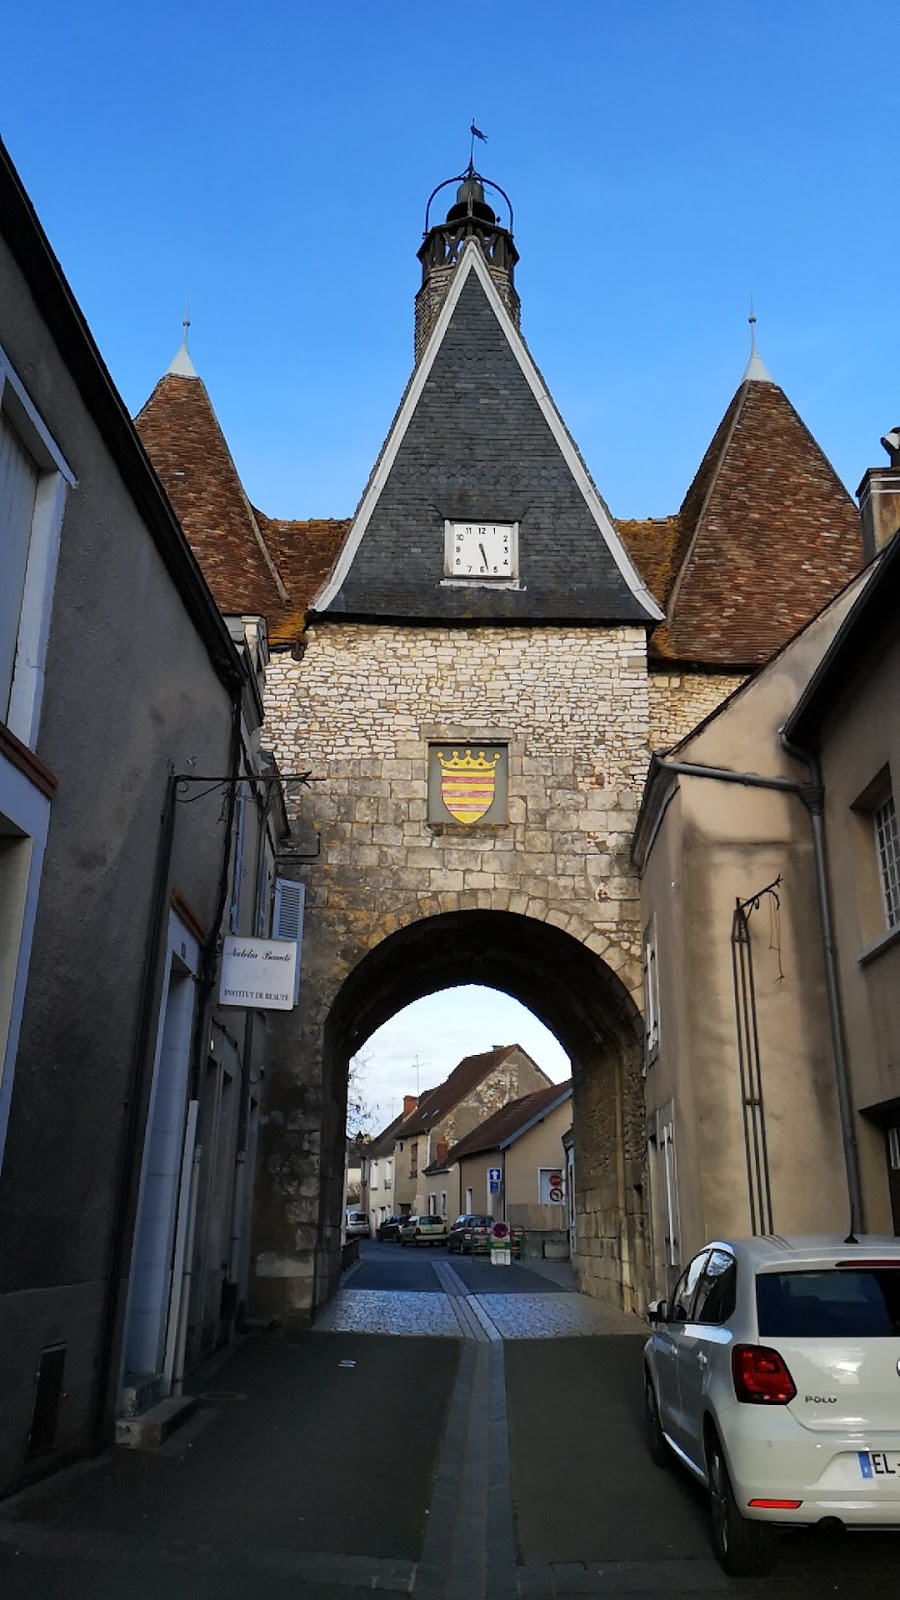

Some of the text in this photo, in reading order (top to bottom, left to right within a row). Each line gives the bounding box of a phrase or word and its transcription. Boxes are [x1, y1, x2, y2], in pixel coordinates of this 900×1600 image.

[503, 535, 508, 543] 2
[493, 566, 498, 574] 5
[224, 988, 255, 999] INSTITUT
[255, 991, 264, 1000] DE
[805, 1395, 838, 1404] POLO
